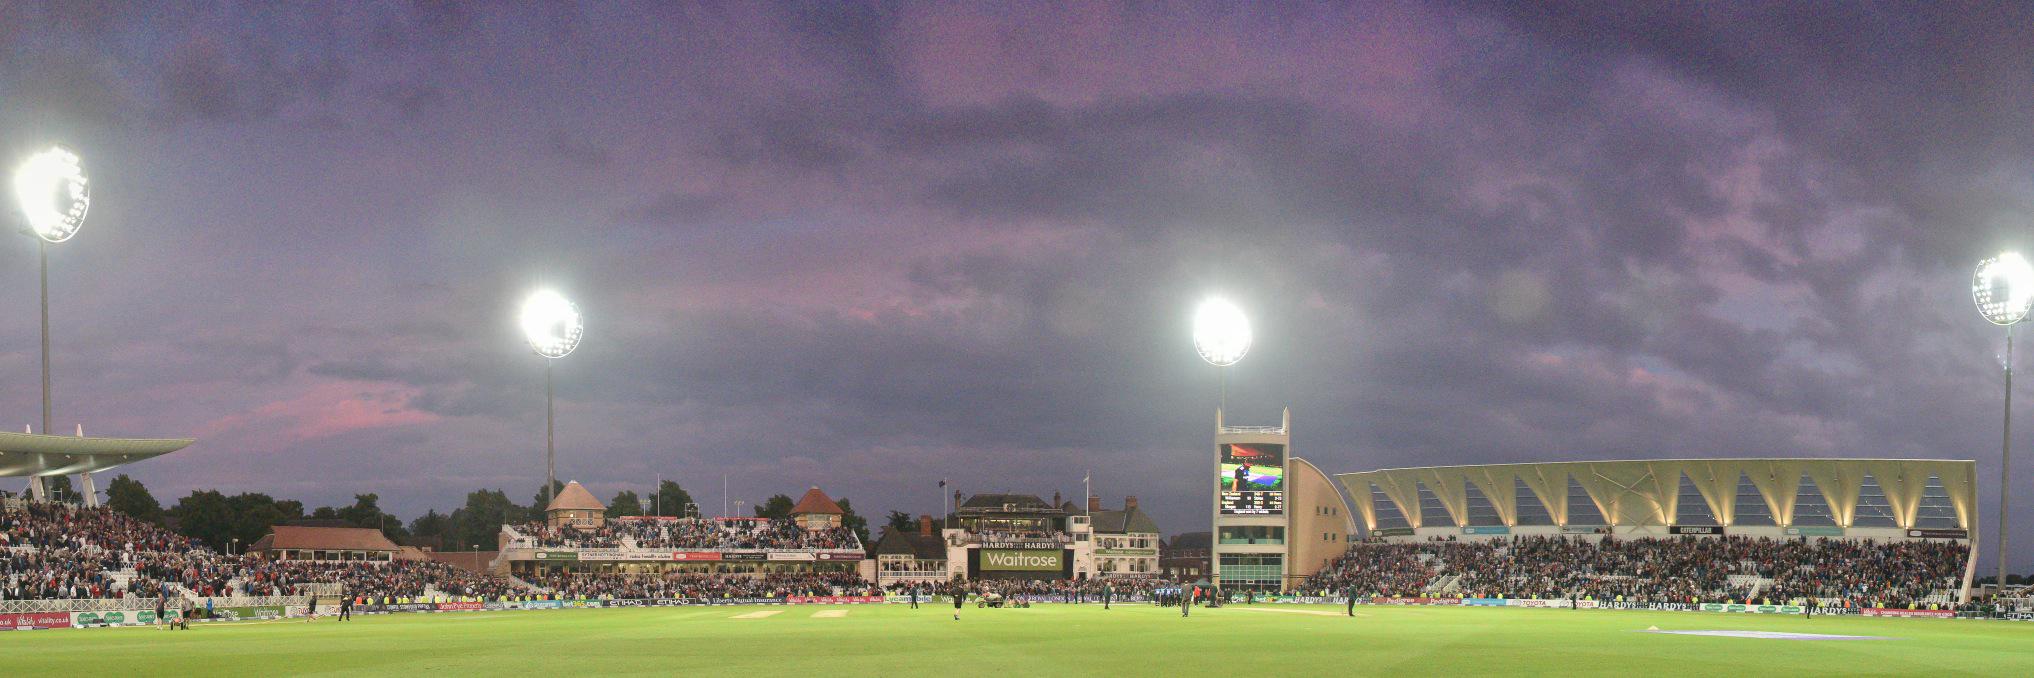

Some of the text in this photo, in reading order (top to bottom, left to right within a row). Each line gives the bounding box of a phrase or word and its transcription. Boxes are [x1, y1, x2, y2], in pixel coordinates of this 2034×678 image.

[987, 551, 1057, 567] Waitrose
[885, 595, 932, 603] Lycambile
[1600, 601, 1637, 609] HARDYS
[1648, 602, 1687, 610] HARDYS
[38, 616, 69, 625] vitality.co.uk
